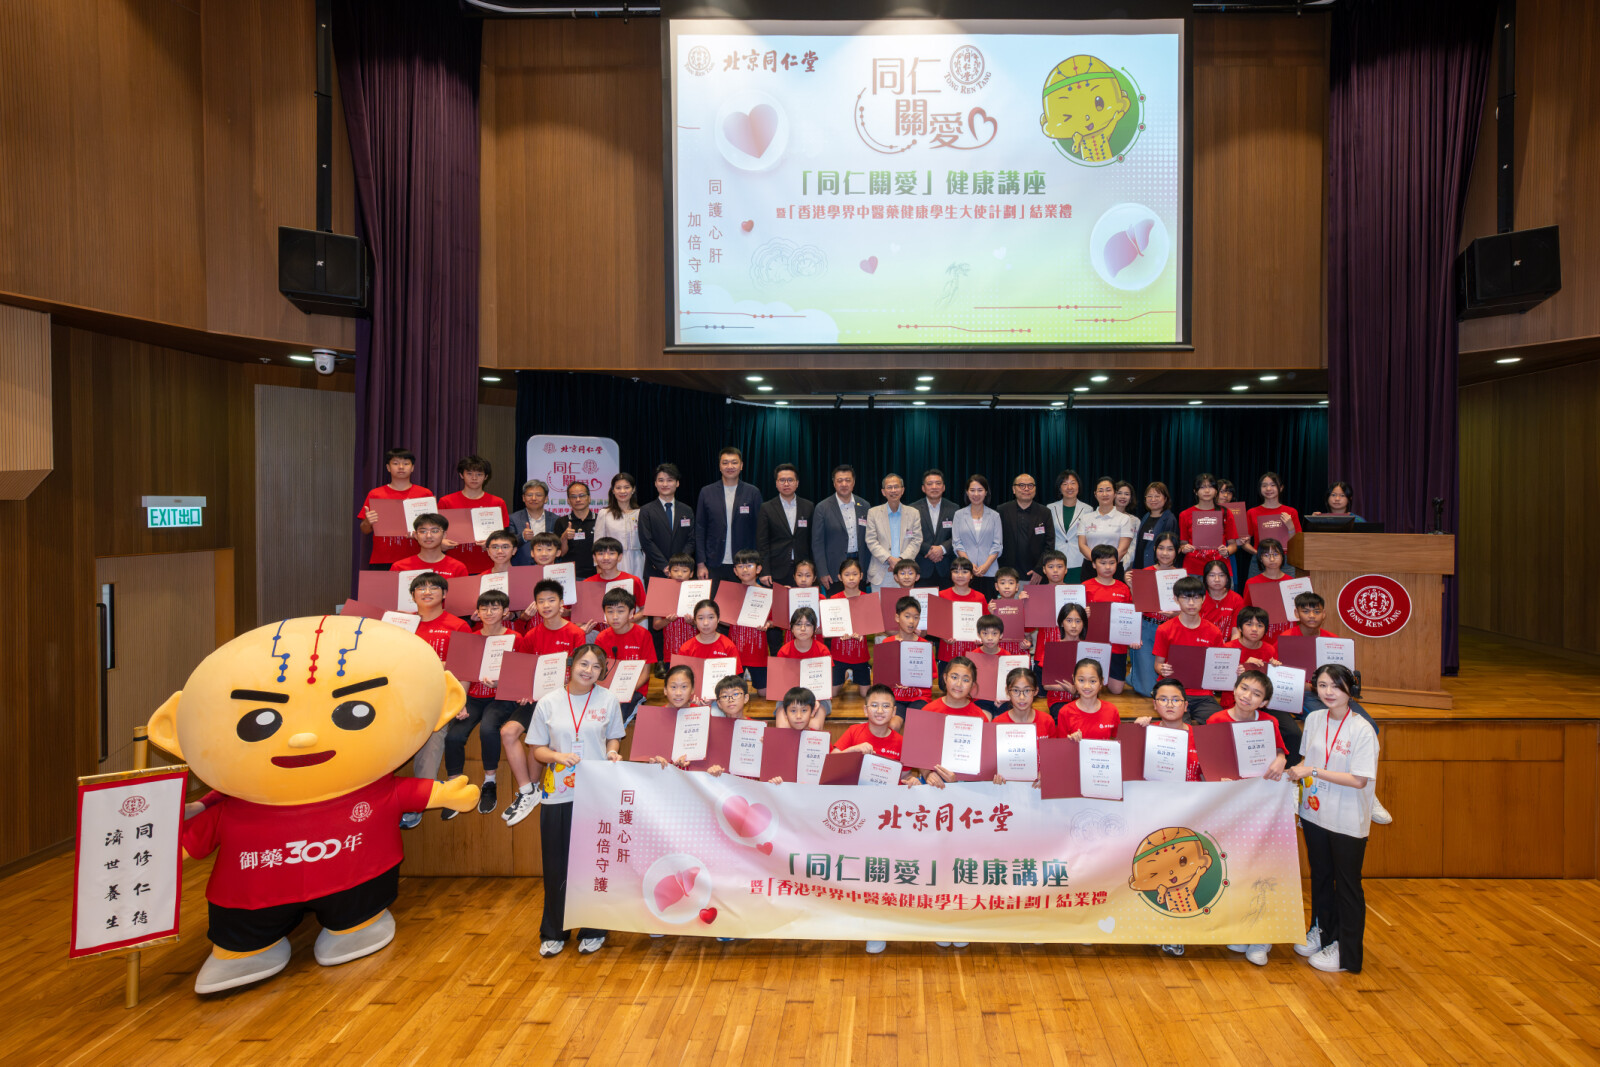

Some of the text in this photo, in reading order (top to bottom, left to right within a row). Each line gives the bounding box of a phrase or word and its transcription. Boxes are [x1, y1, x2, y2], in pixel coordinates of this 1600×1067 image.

[722, 49, 819, 73] 北京同仁堂
[872, 57, 942, 95] 同仁
[944, 71, 992, 94] TONG REN TANG
[895, 98, 964, 149] 關愛
[708, 179, 723, 263] 同護心肝
[687, 211, 702, 295] 加倍守護
[151, 508, 178, 526] EXIT
[178, 508, 201, 525] 出口
[1347, 607, 1402, 628] TONG REN TANG
[617, 789, 635, 863] 同護心肝
[878, 802, 1014, 832] 北京同仁堂
[239, 832, 363, 870] 御藥300年
[593, 819, 611, 892] 加倍守護
